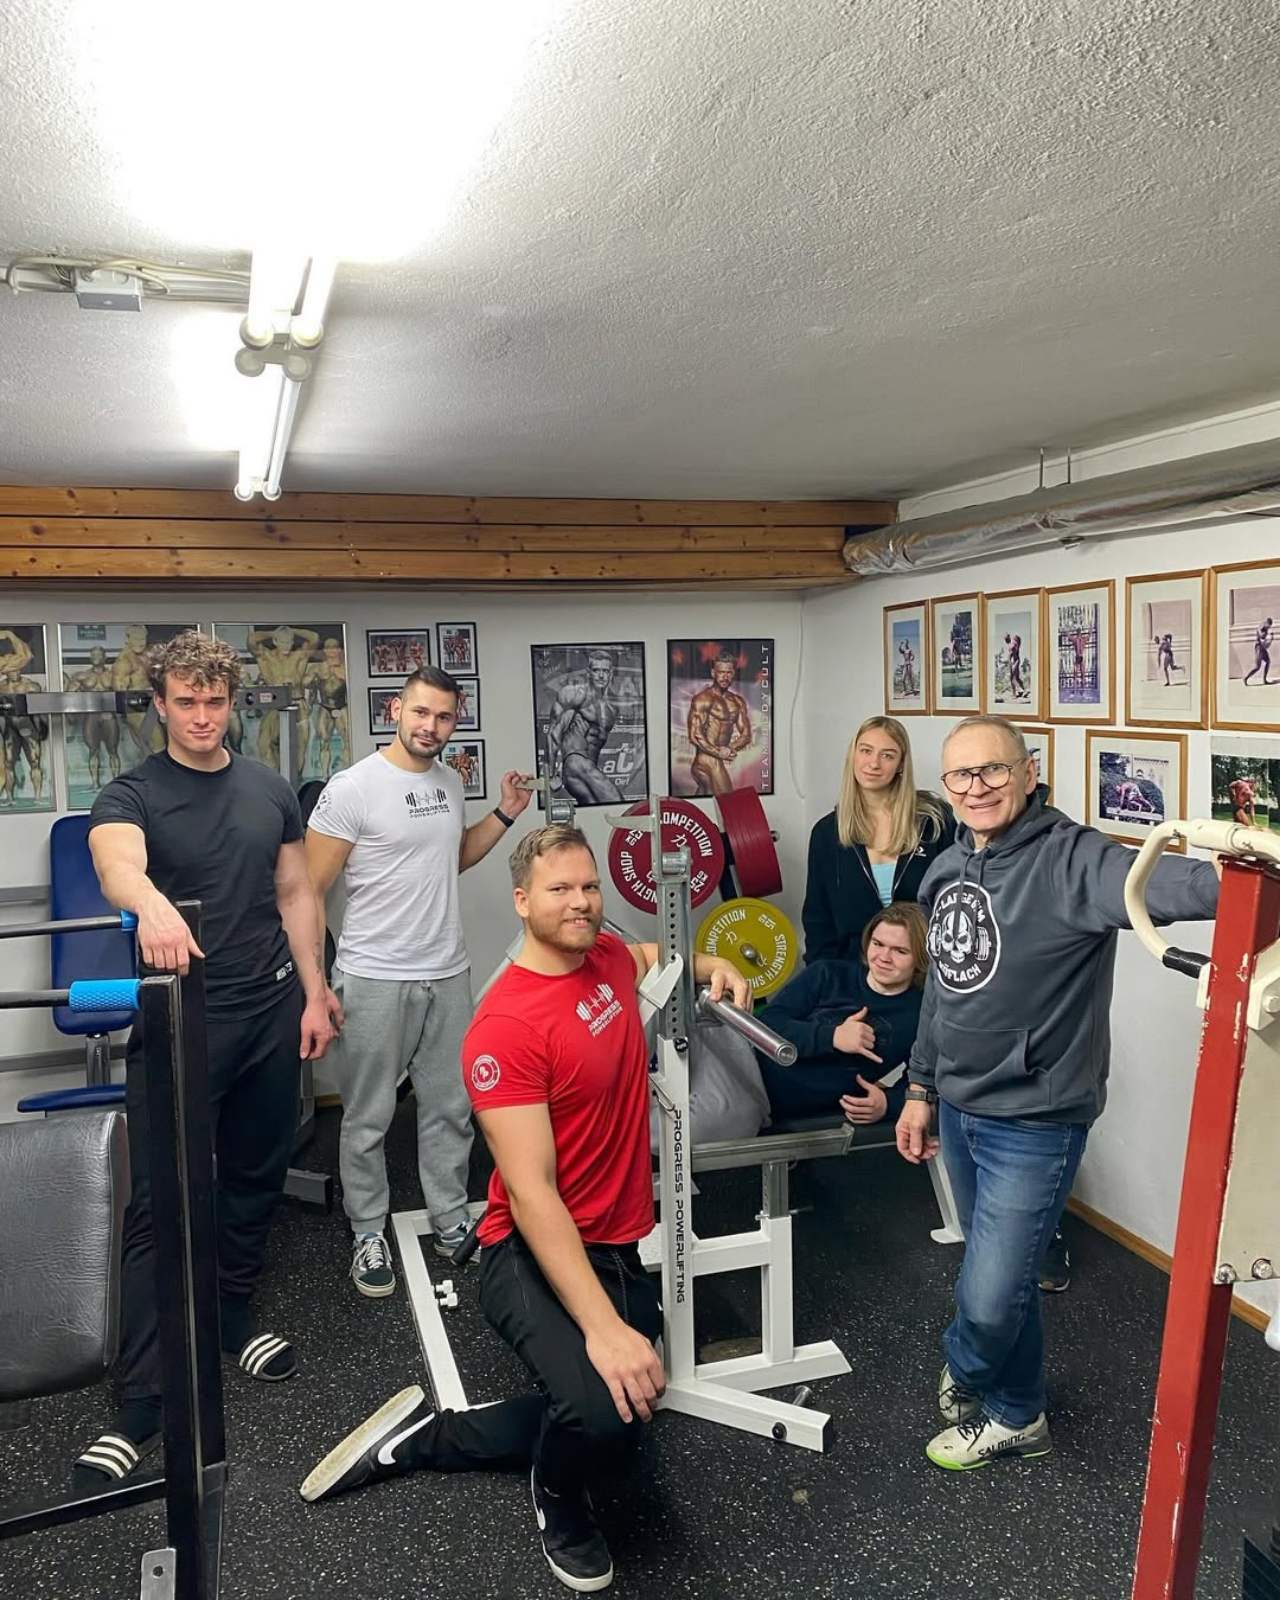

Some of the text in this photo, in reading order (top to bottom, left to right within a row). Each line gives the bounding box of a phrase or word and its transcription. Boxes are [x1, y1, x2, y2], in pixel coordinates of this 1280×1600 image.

[659, 811, 714, 857] OMPETITION
[620, 850, 638, 882] SHOP
[705, 908, 747, 957] OMPETITION
[765, 933, 788, 981] STRENGTH
[673, 1108, 685, 1304] PROGRESS POWERLIFTING
